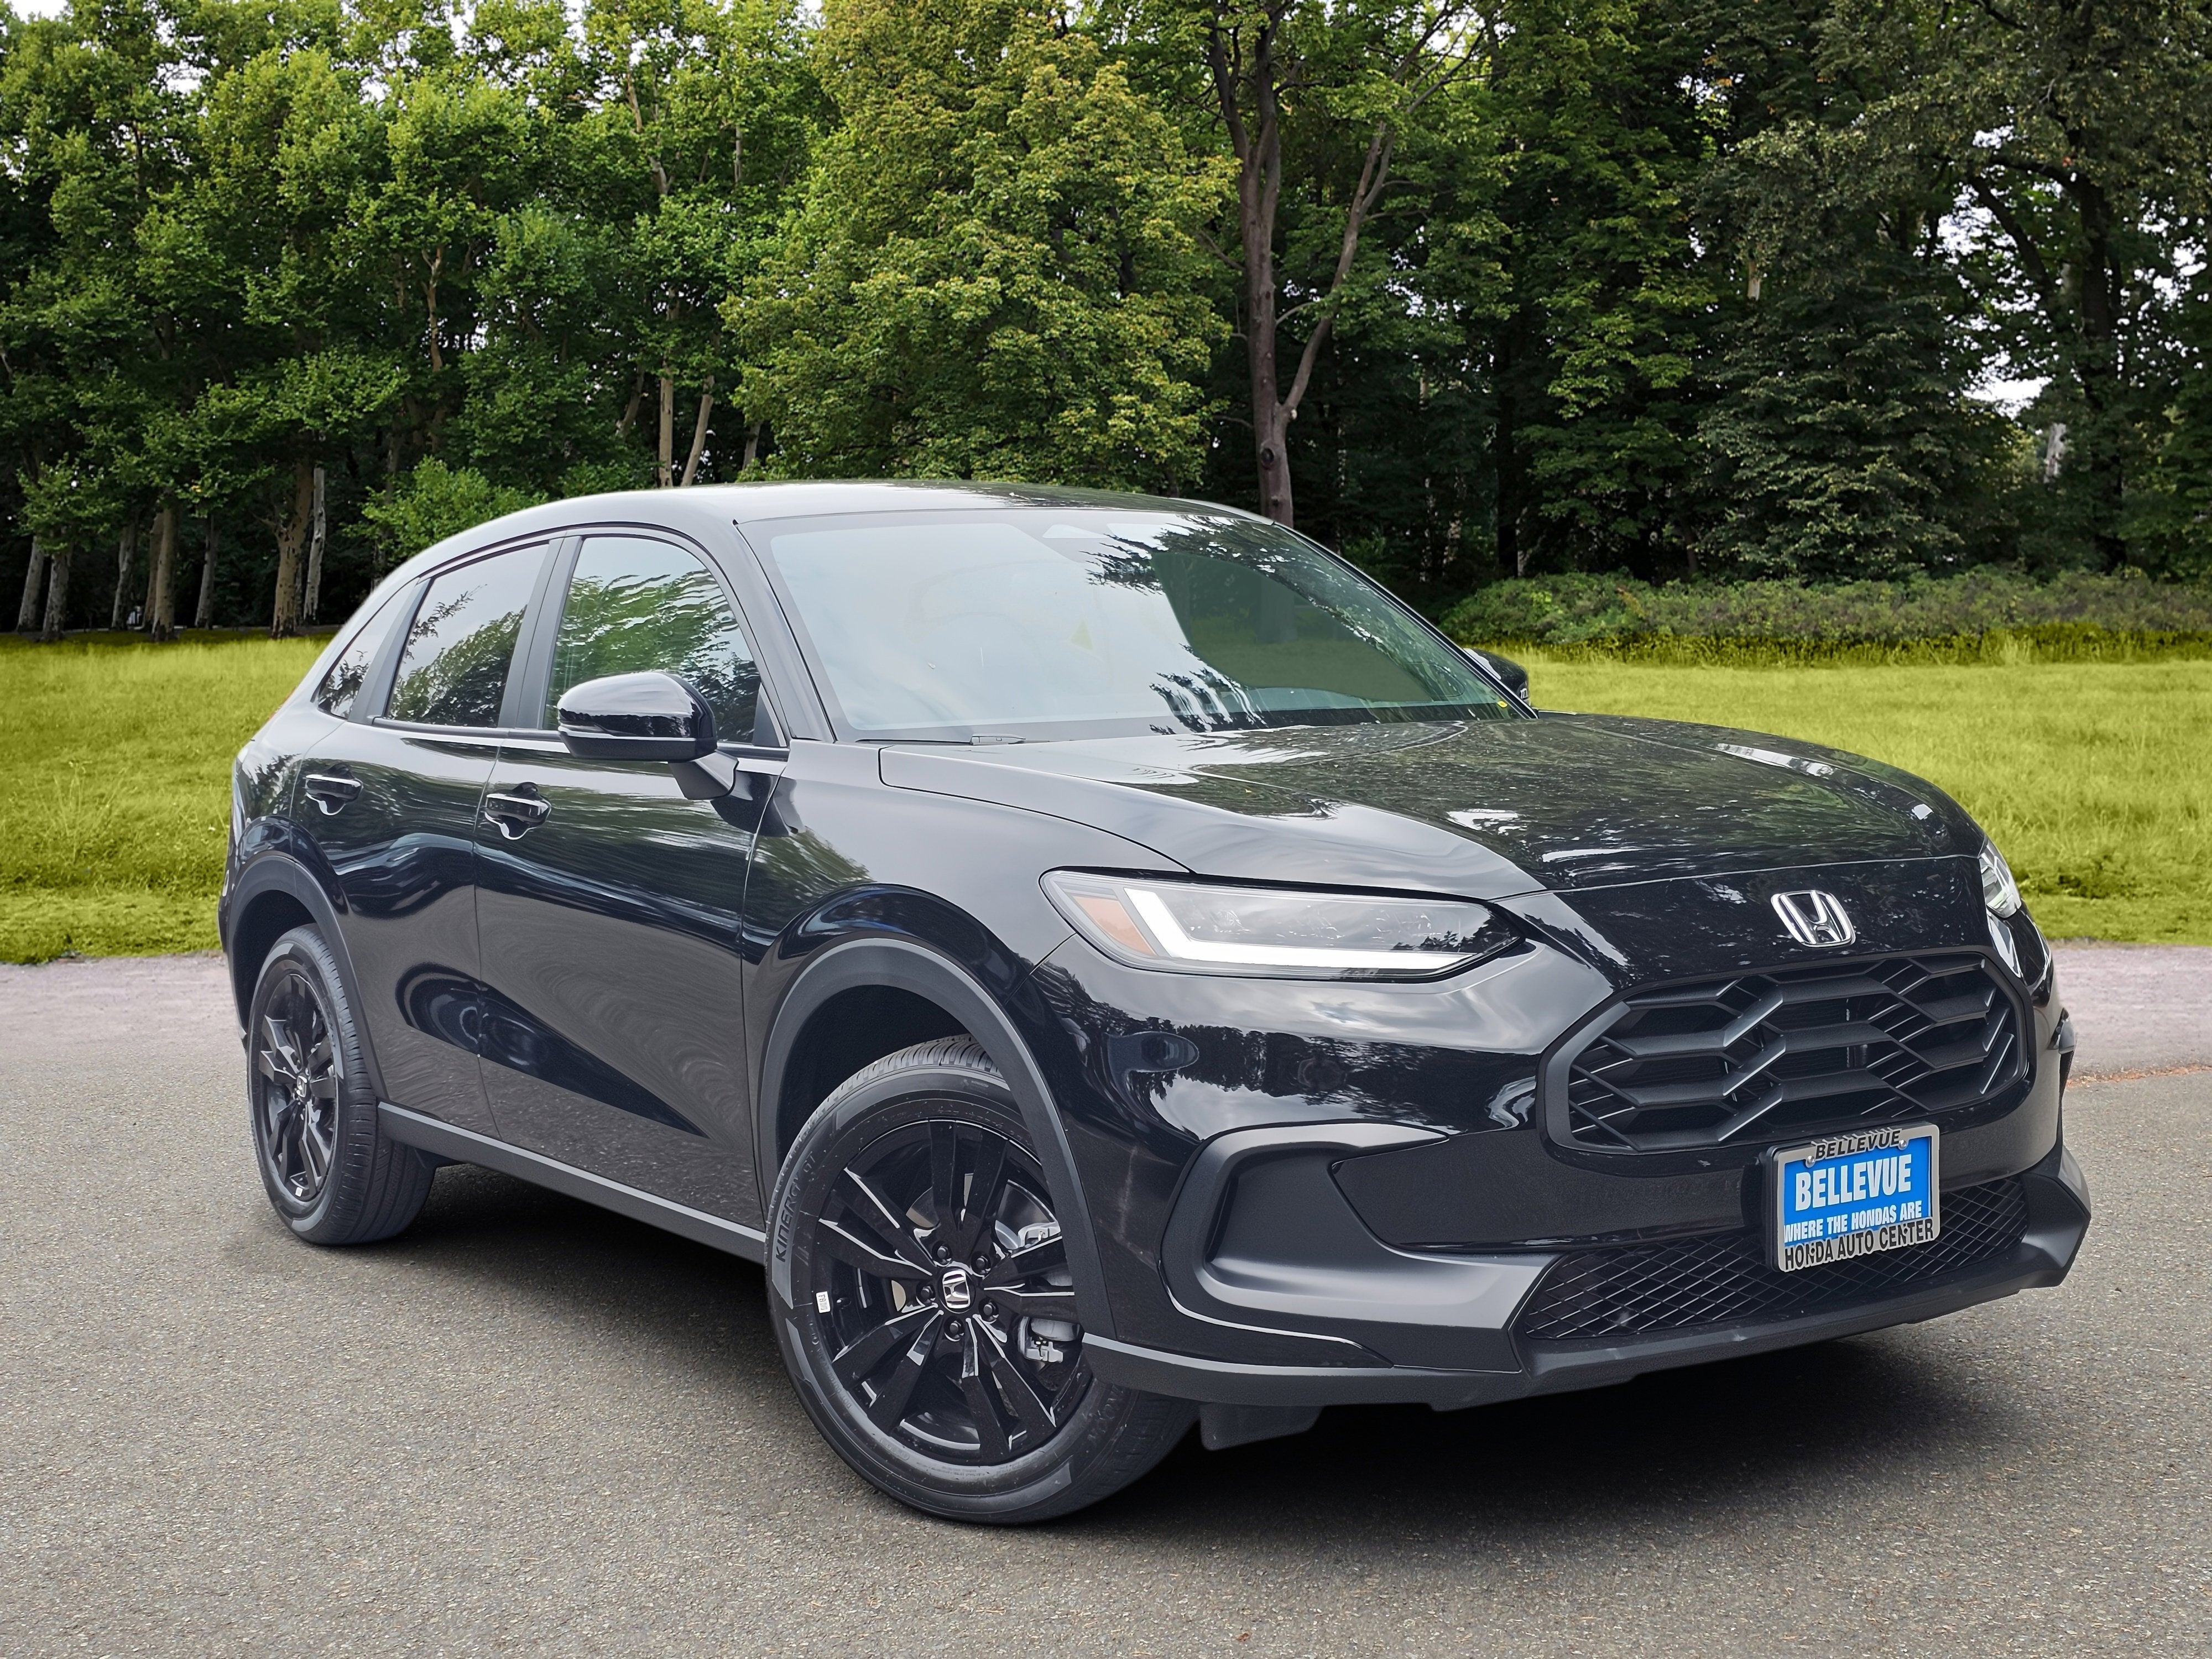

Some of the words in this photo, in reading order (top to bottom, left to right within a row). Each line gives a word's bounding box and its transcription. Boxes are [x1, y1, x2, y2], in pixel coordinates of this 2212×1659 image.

[1815, 1130, 1900, 1159] BELLEVUE
[1796, 1154, 1911, 1211] BELLEVUE
[1784, 1219, 1823, 1243] WHERE
[1827, 1214, 1848, 1234] THE
[1852, 1205, 1896, 1229] HONDAS
[1900, 1200, 1922, 1220] ARE
[1785, 1240, 1833, 1270] HONDA
[1837, 1230, 1874, 1259] AUTO
[1879, 1219, 1933, 1246] CENTER
